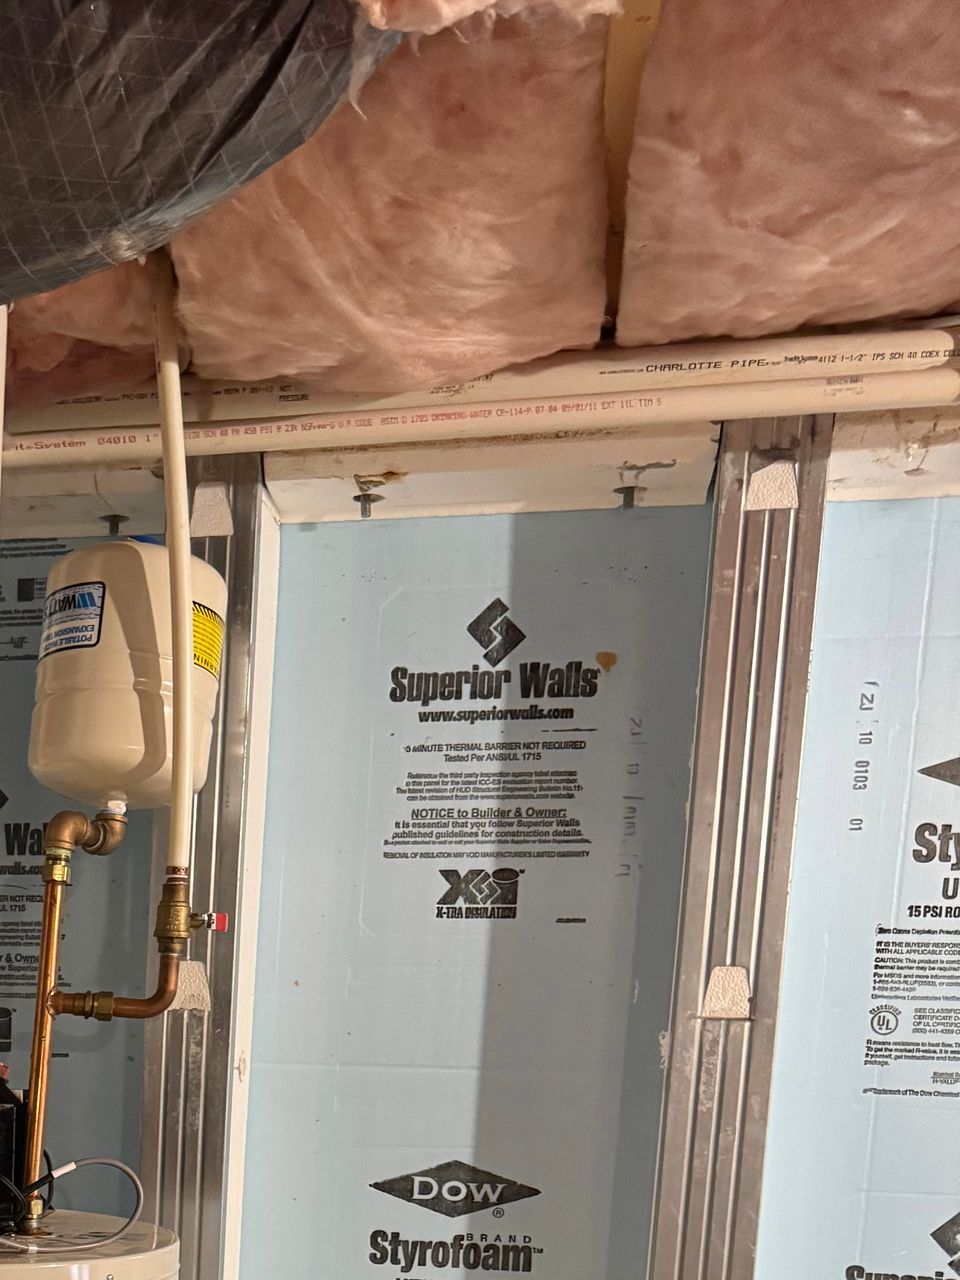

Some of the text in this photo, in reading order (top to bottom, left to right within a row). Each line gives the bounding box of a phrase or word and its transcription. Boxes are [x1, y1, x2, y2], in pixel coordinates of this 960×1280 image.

[646, 361, 722, 373] CHARLOTTE
[819, 355, 836, 363] 4112
[873, 352, 885, 360] IPS
[889, 351, 904, 360] SCH
[908, 351, 917, 359] 40
[389, 661, 598, 706] Superior Walls
[418, 705, 574, 724] www.superiorwalls.com
[412, 744, 444, 753] MINUTE
[445, 743, 483, 751] THERMAL
[484, 742, 521, 750] BARRIER
[542, 741, 586, 750] REQUIRED
[444, 752, 542, 762] Tested Per 1715
[848, 731, 873, 831] 10 0103 01
[411, 807, 567, 819] NOTICE to Builder & Owner:
[402, 818, 580, 830] is essential that you follow Superior Walls
[392, 830, 433, 840] published
[435, 829, 479, 839] guidelines
[481, 829, 493, 838] for
[495, 828, 551, 838] construction
[552, 828, 584, 837] details.
[9, 904, 26, 912] 1715
[907, 906, 941, 918] 15 PSI
[411, 1175, 507, 1203] DOW
[466, 1233, 532, 1245] BRAND
[368, 1230, 532, 1274] Styrofoam
